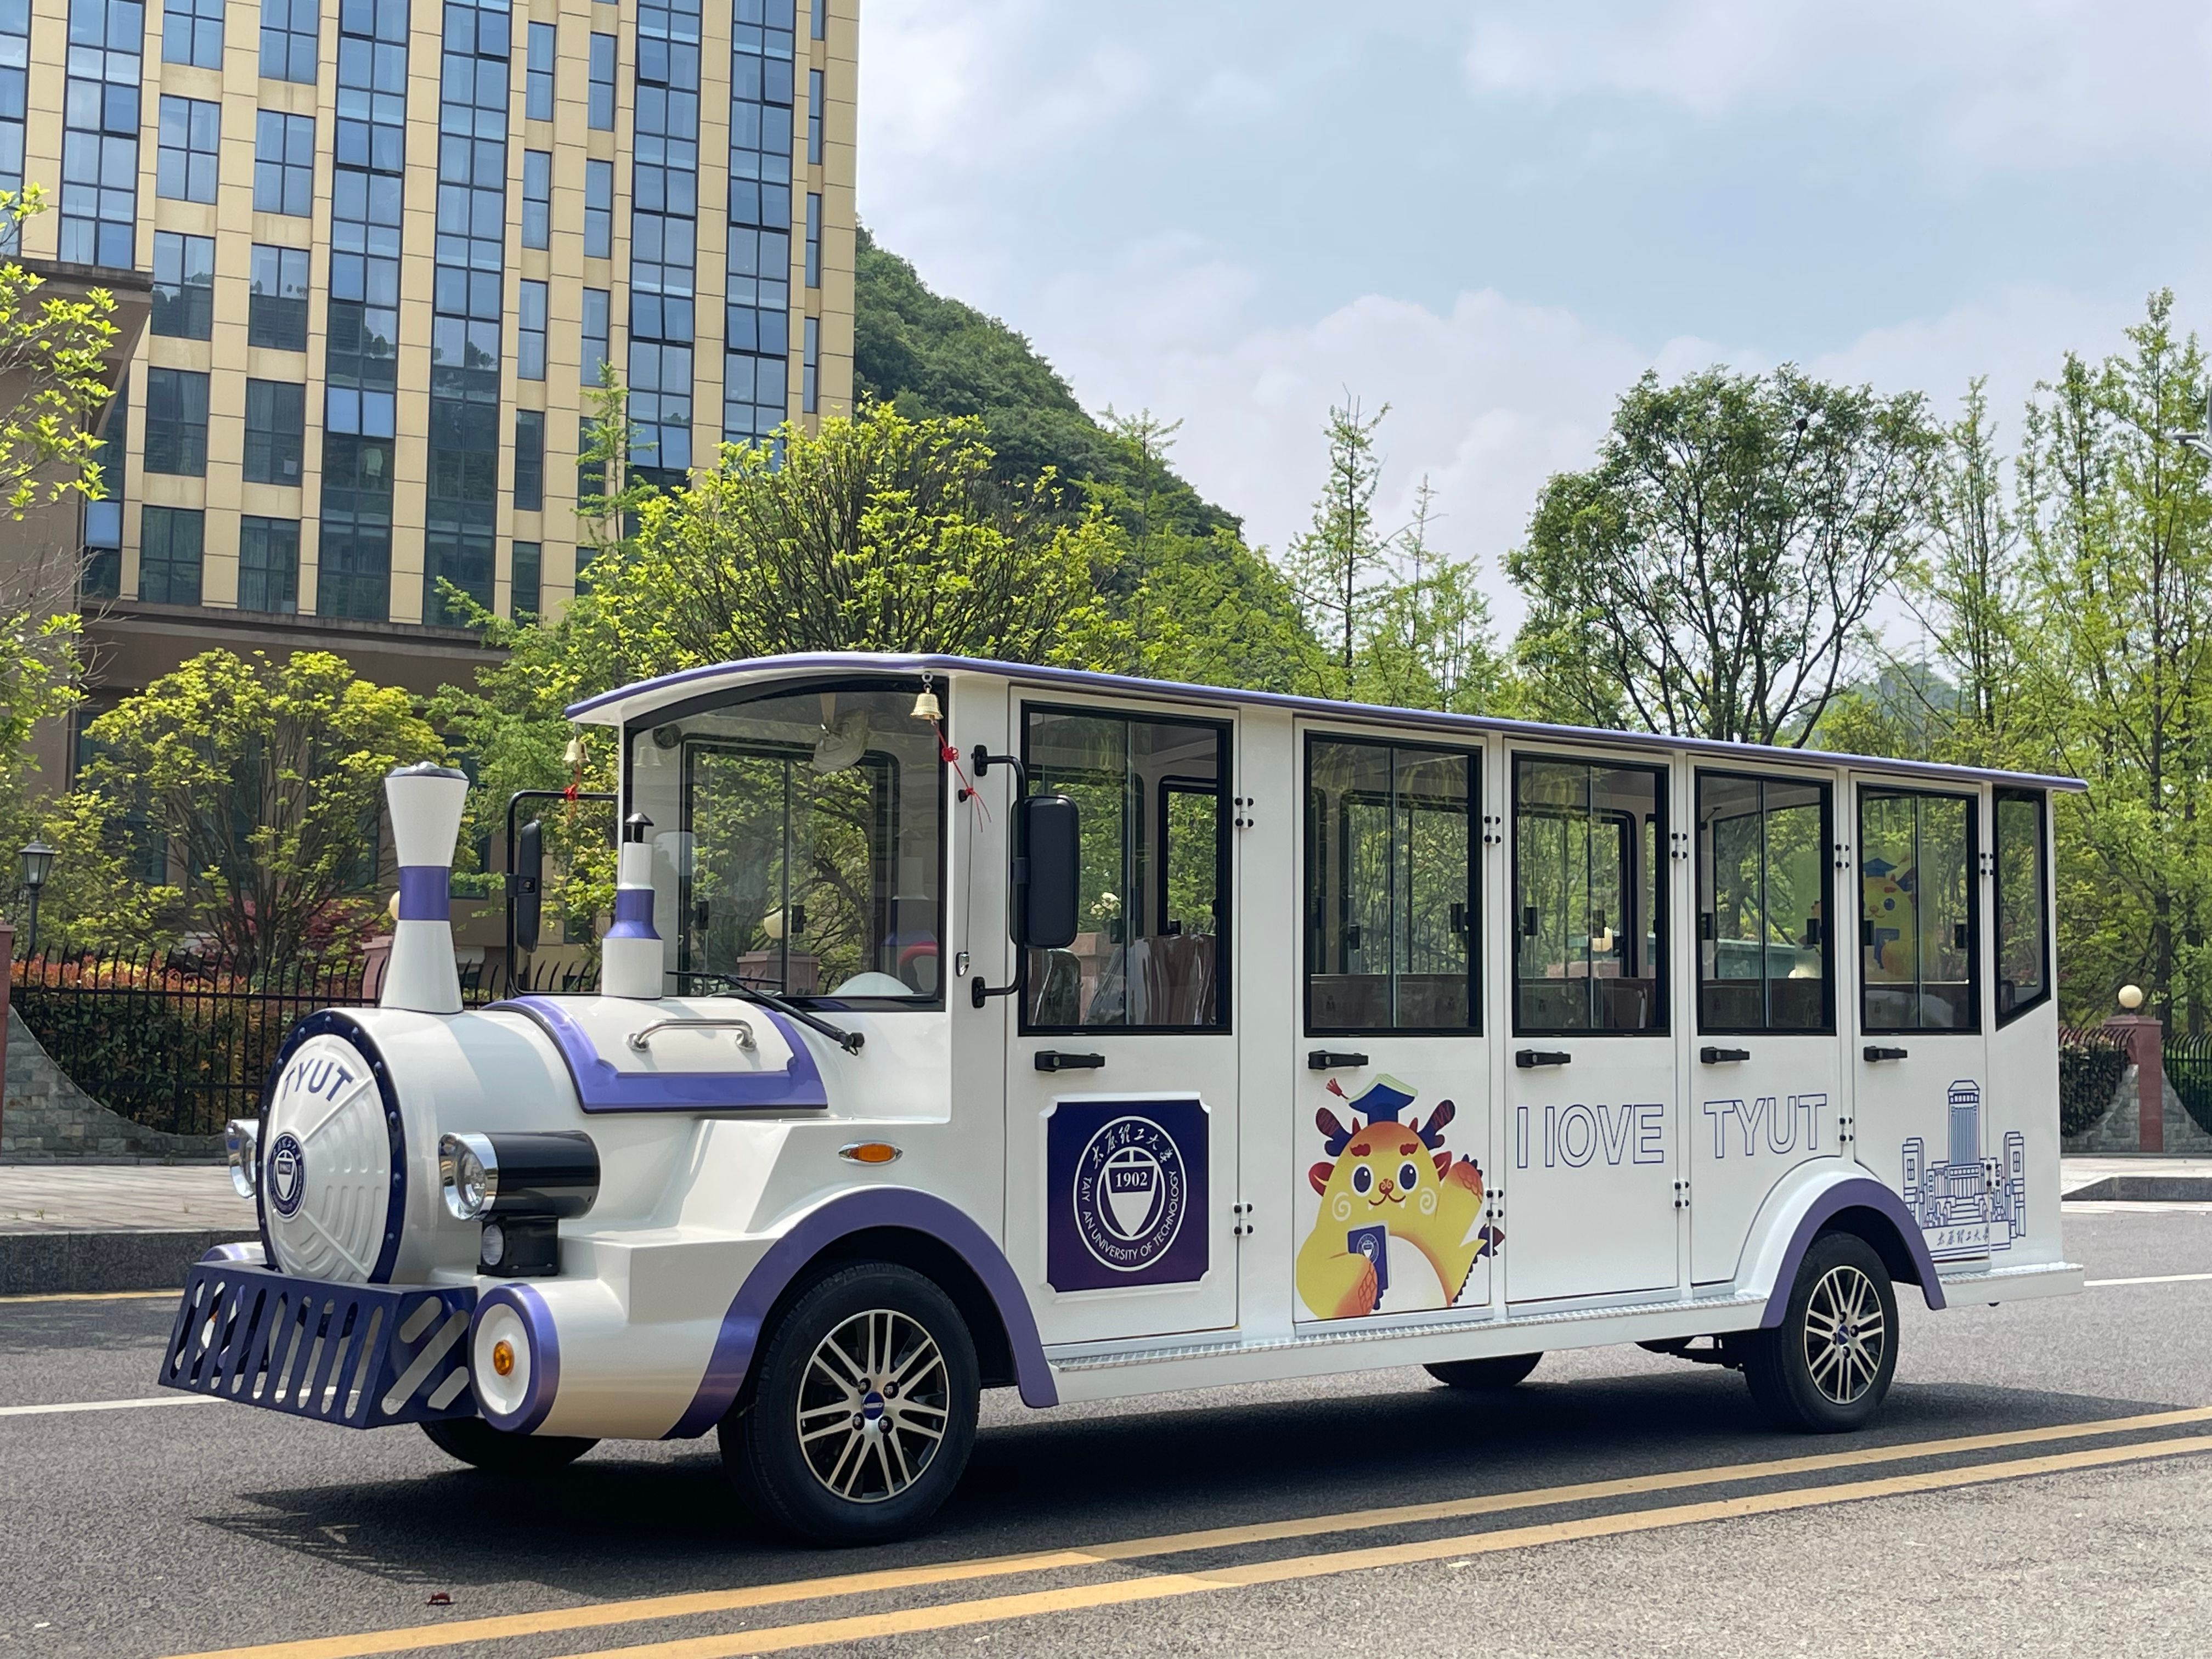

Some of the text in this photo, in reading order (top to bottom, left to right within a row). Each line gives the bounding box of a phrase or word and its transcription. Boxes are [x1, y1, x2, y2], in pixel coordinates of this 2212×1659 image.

[282, 1058, 354, 1101] TYUT
[1517, 1107, 1528, 1169] I
[1704, 1094, 1827, 1159] TYUT
[1115, 1172, 1148, 1187] 1902
[1092, 1228, 1138, 1260] UNIVERSITY
[1140, 1242, 1152, 1257] OF
[1153, 1171, 1179, 1246] TECHNOLOGY
